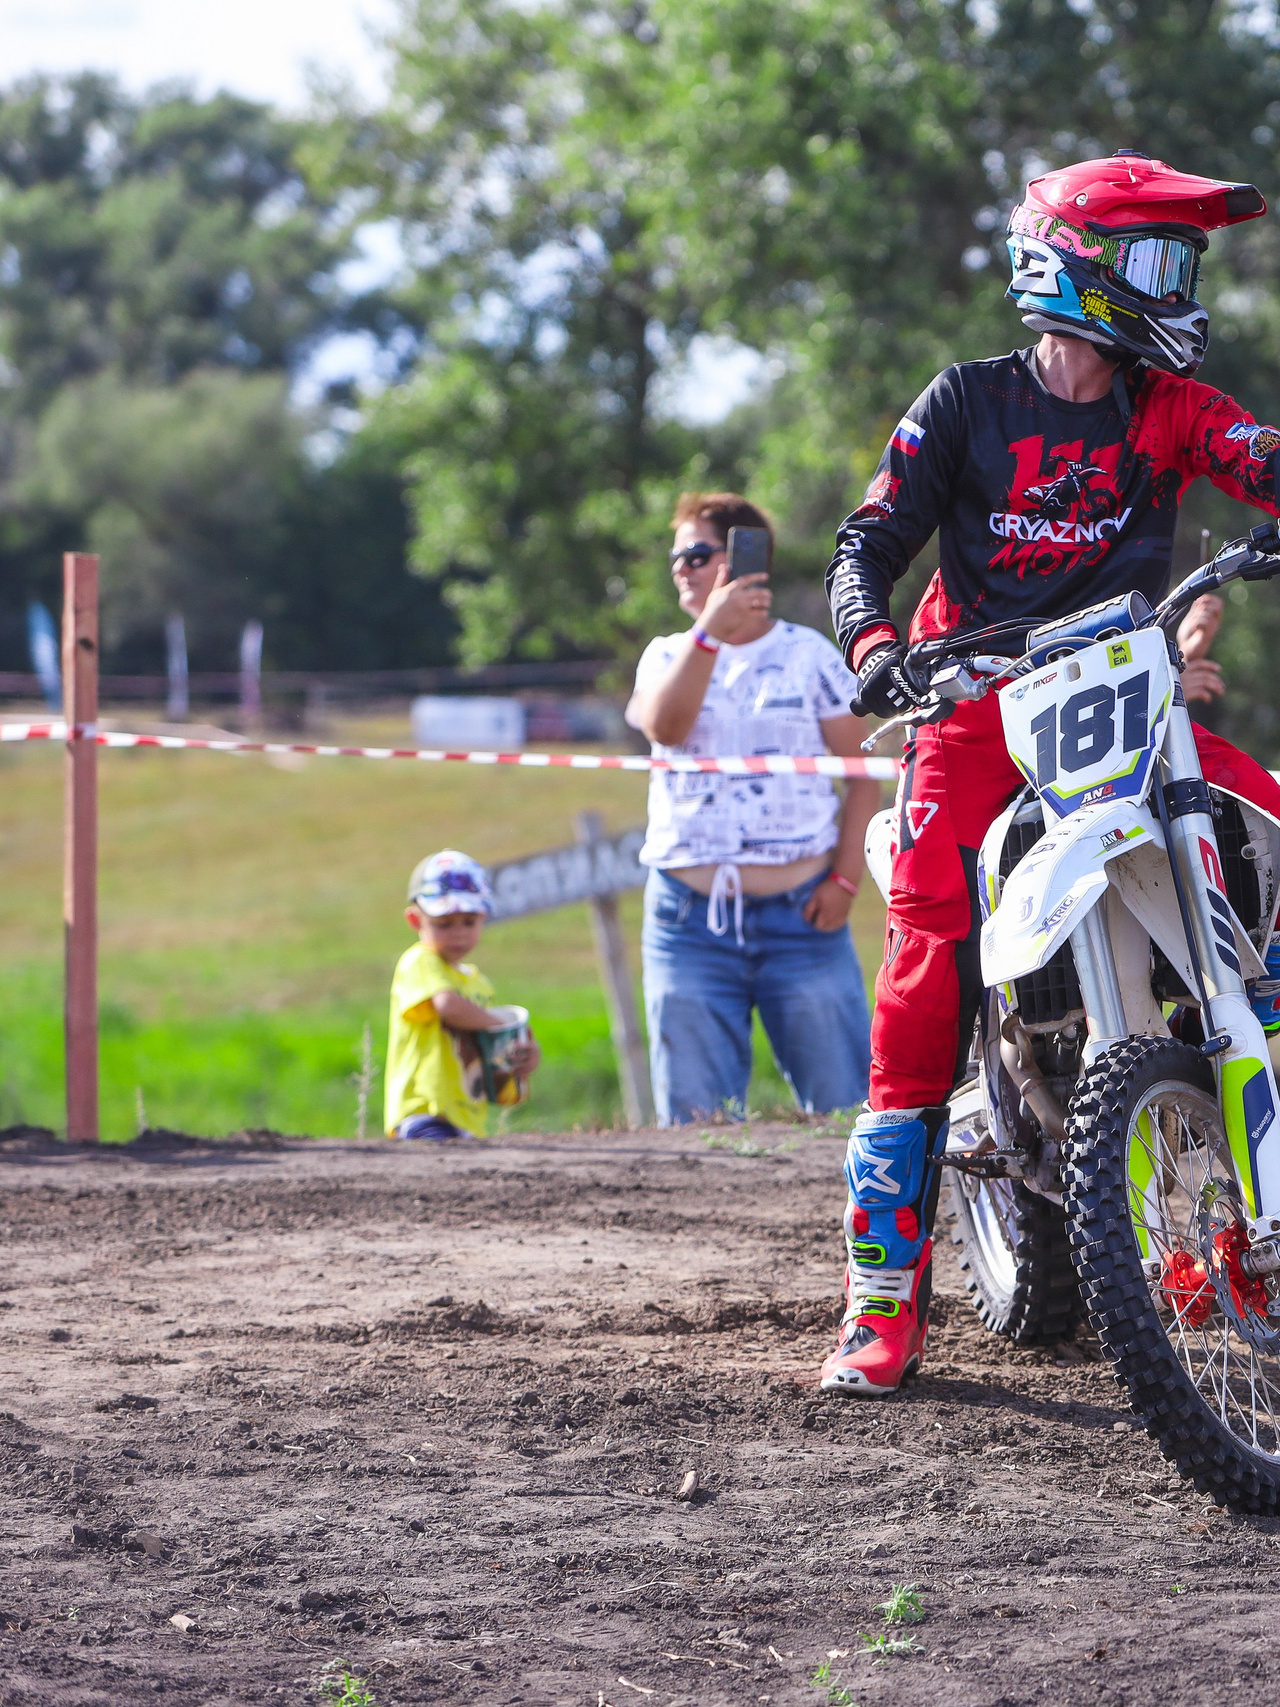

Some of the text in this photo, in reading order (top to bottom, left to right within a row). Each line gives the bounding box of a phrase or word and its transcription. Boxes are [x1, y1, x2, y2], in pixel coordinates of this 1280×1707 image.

[1085, 296, 1107, 312] EURO
[988, 507, 1133, 543] GRYAZNOV
[988, 538, 1111, 581] MOTO
[1033, 594, 1126, 638] SCAR
[1032, 671, 1058, 690] MXGP
[1030, 669, 1150, 790] 181
[1032, 895, 1075, 937] XTRIG
